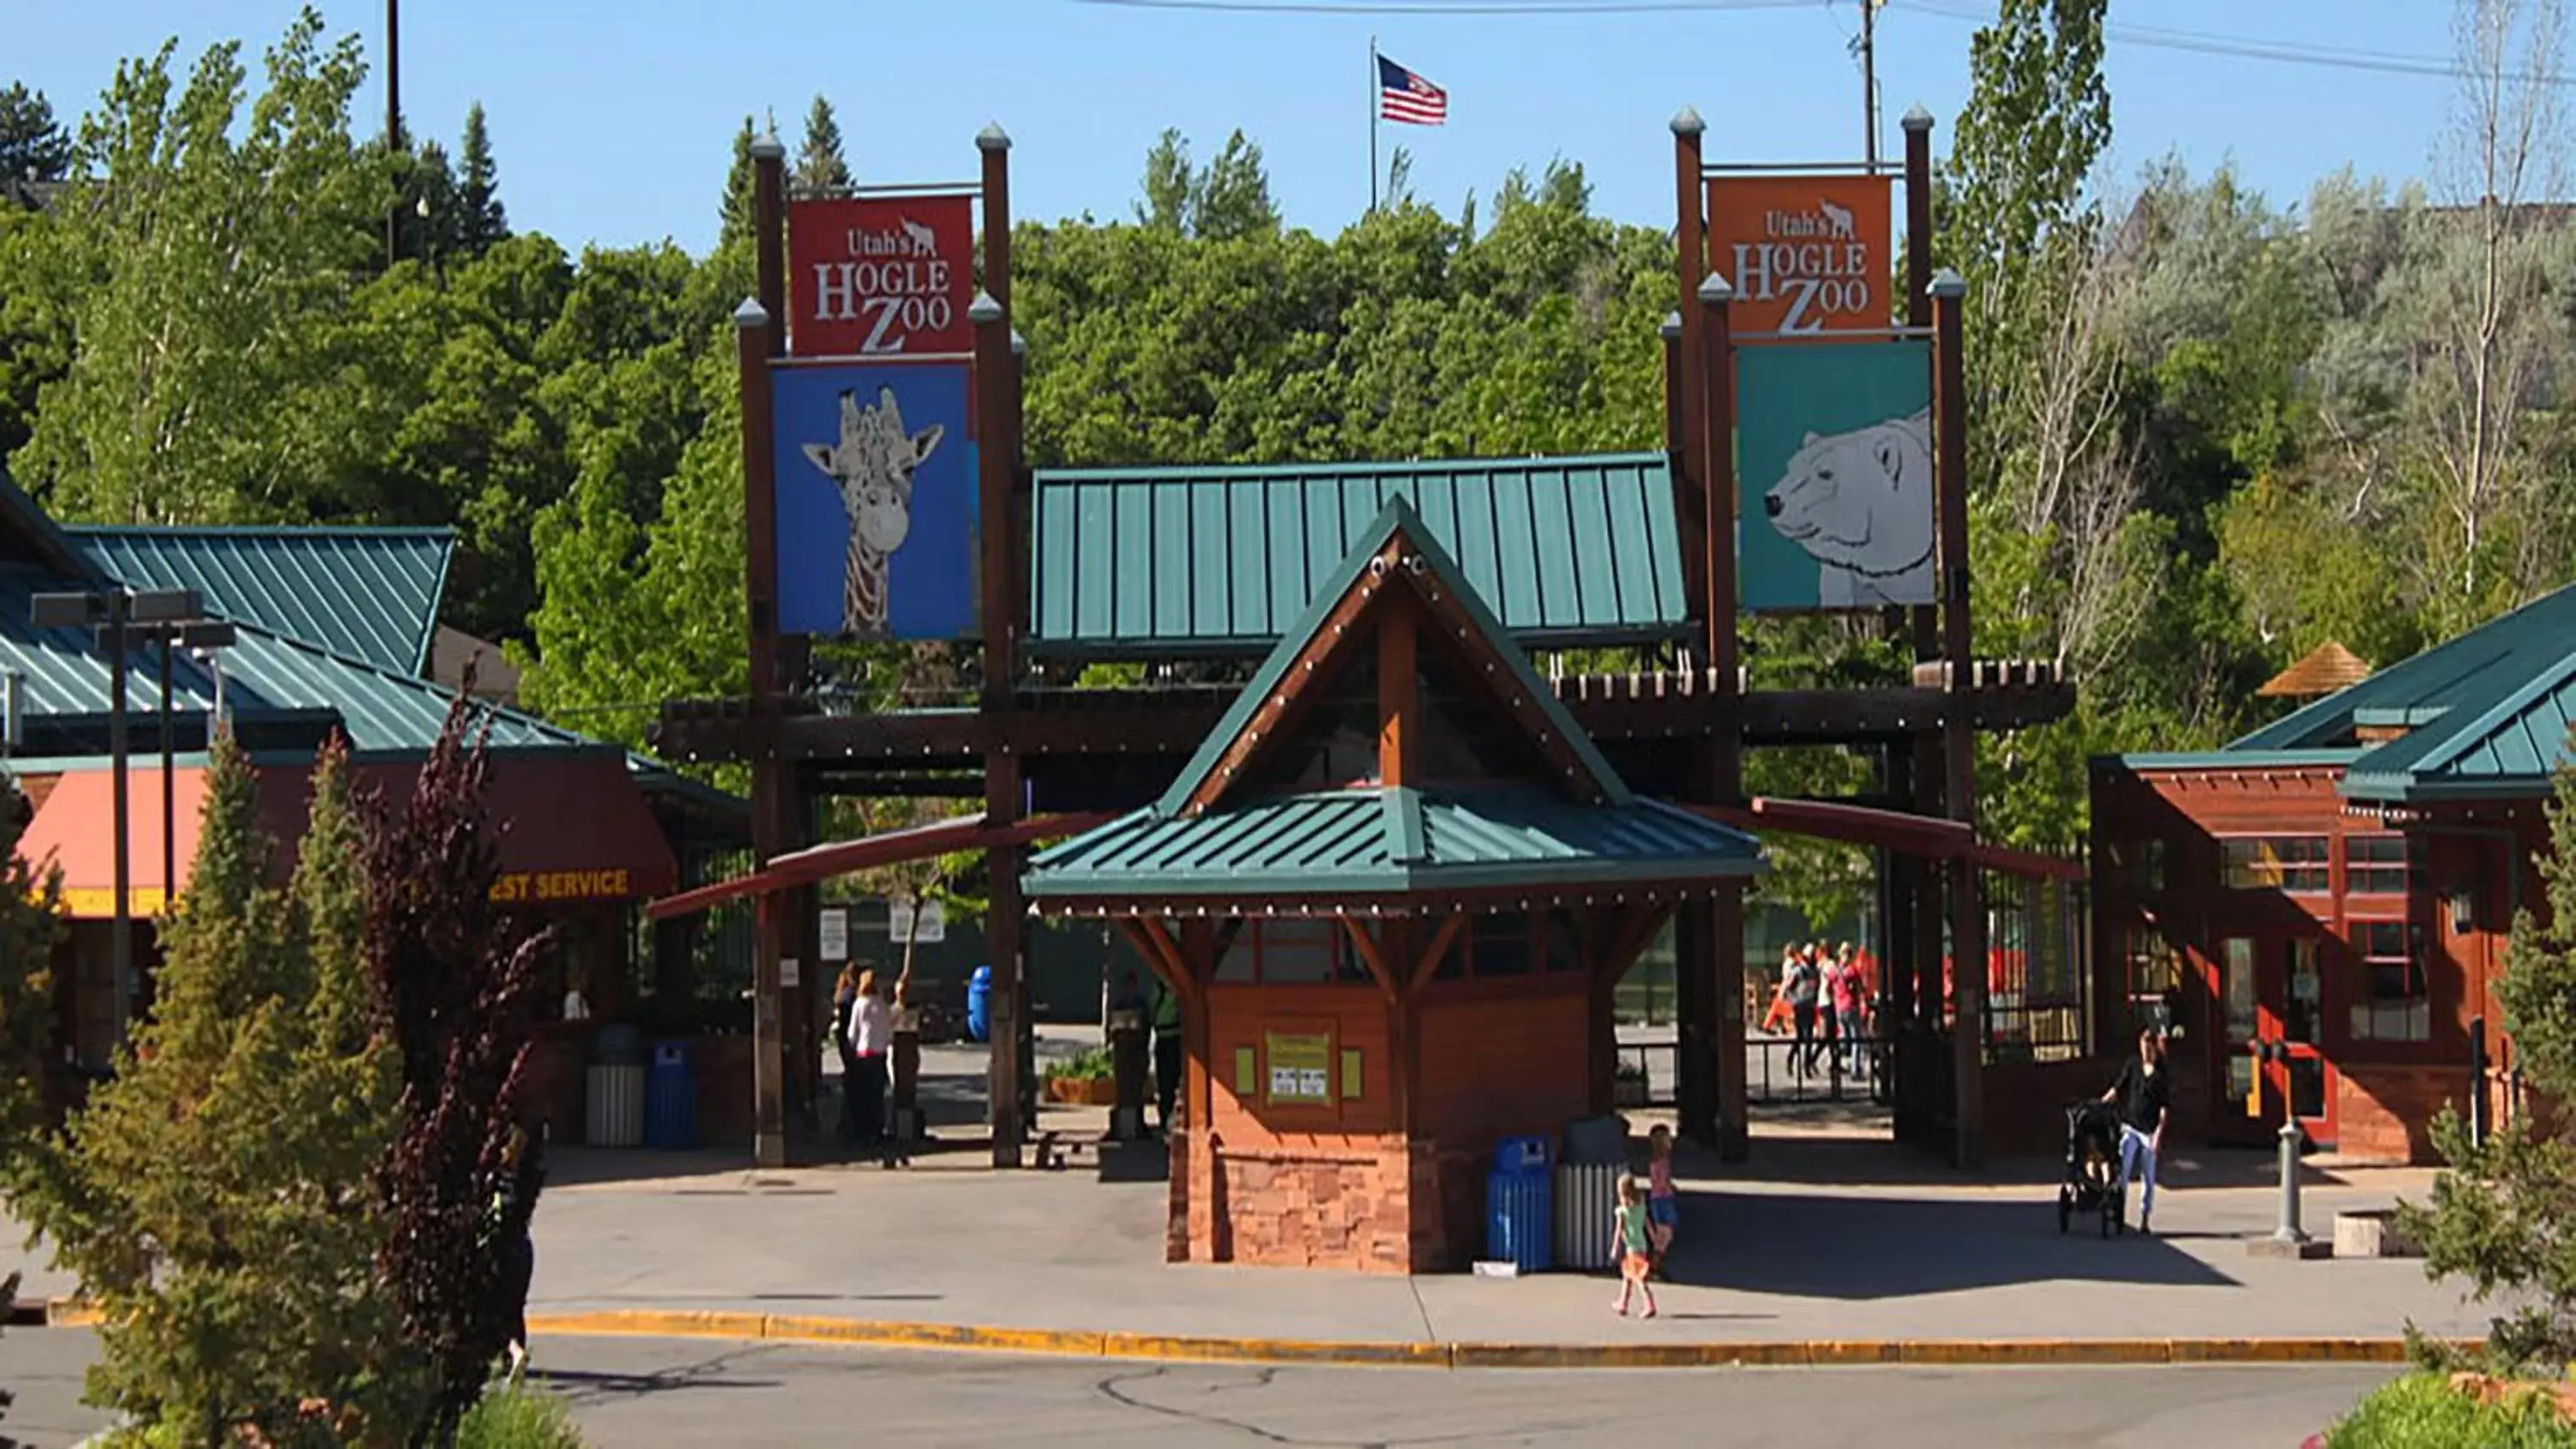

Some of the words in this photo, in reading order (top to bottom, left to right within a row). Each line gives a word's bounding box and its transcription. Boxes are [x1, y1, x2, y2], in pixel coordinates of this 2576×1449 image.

[848, 229, 909, 256] Utah's
[1766, 210, 1828, 237] Utah's
[813, 261, 950, 321] HOGLE
[1731, 243, 1867, 301] HOGLE
[861, 295, 951, 354] ZOO
[1779, 278, 1868, 336] ZOO
[489, 873, 530, 901] EST
[536, 870, 628, 899] SERVICE
